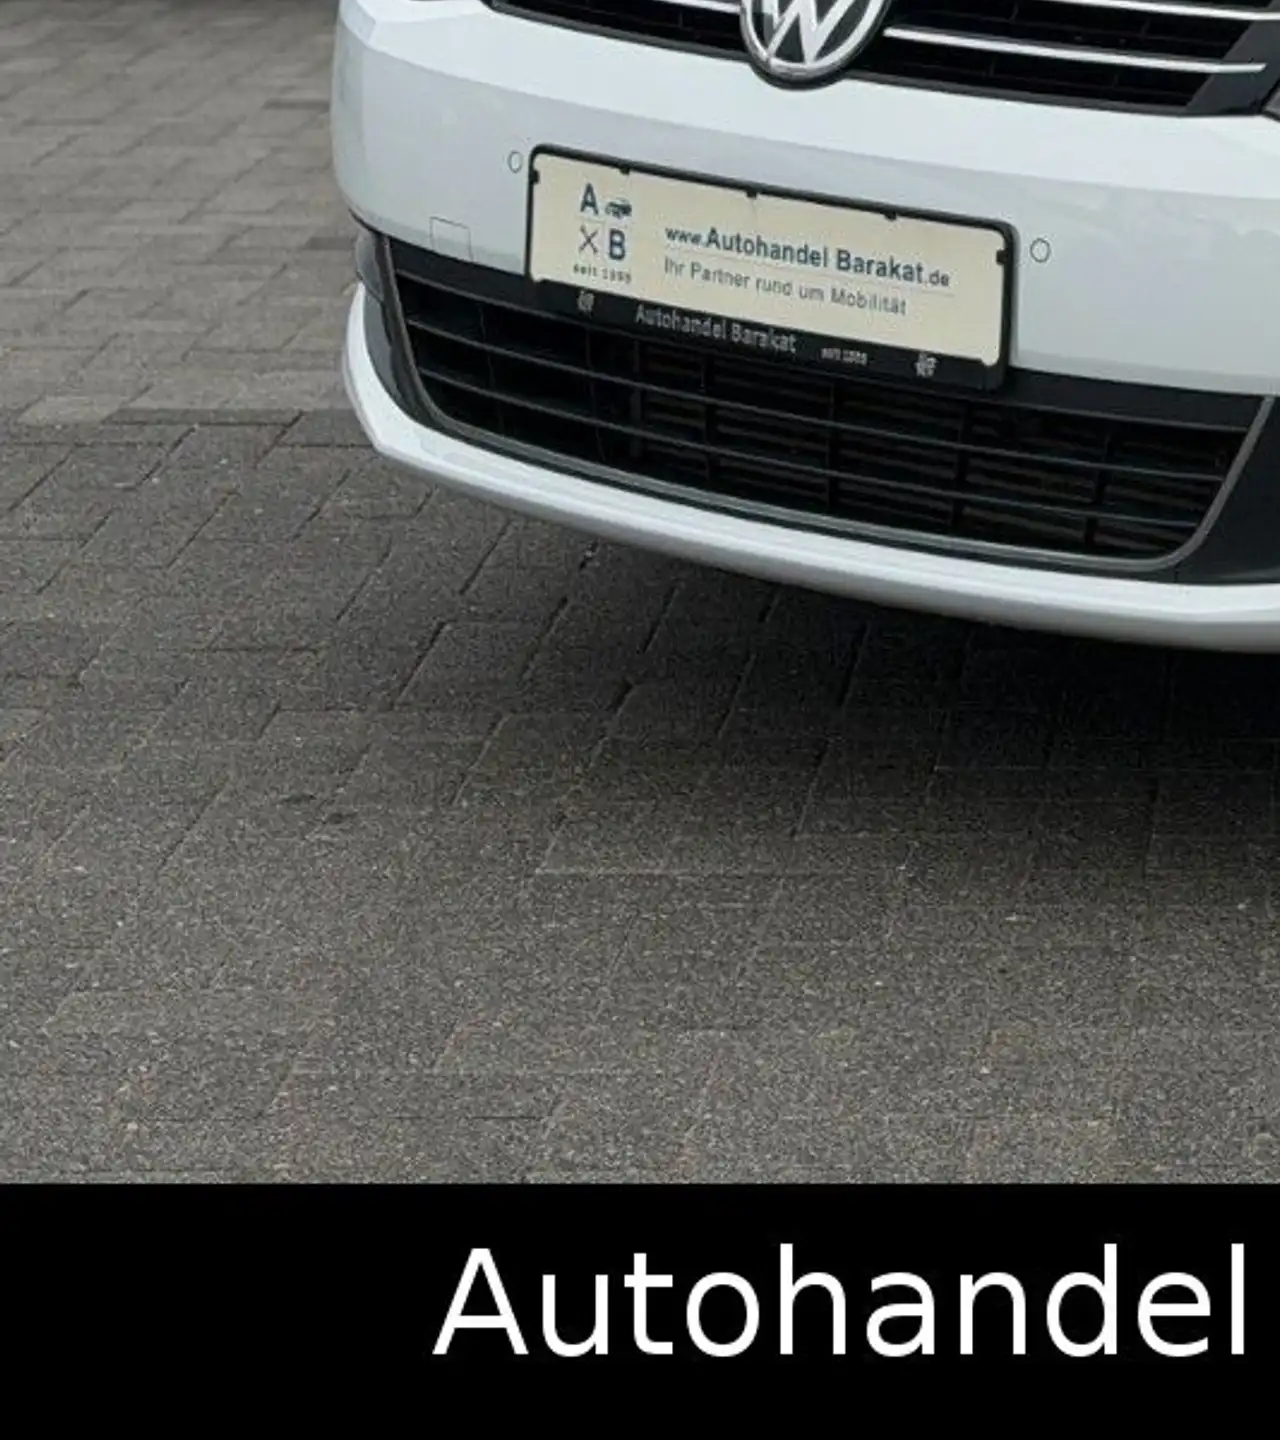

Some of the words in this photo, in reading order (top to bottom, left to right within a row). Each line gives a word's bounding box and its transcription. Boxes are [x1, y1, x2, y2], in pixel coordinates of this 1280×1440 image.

[664, 256, 685, 277] Ihr
[690, 261, 751, 291] Partner
[756, 275, 793, 298] rund
[799, 285, 825, 303] um
[665, 226, 829, 268] www.Autohandel
[836, 248, 951, 288] Barakat.de
